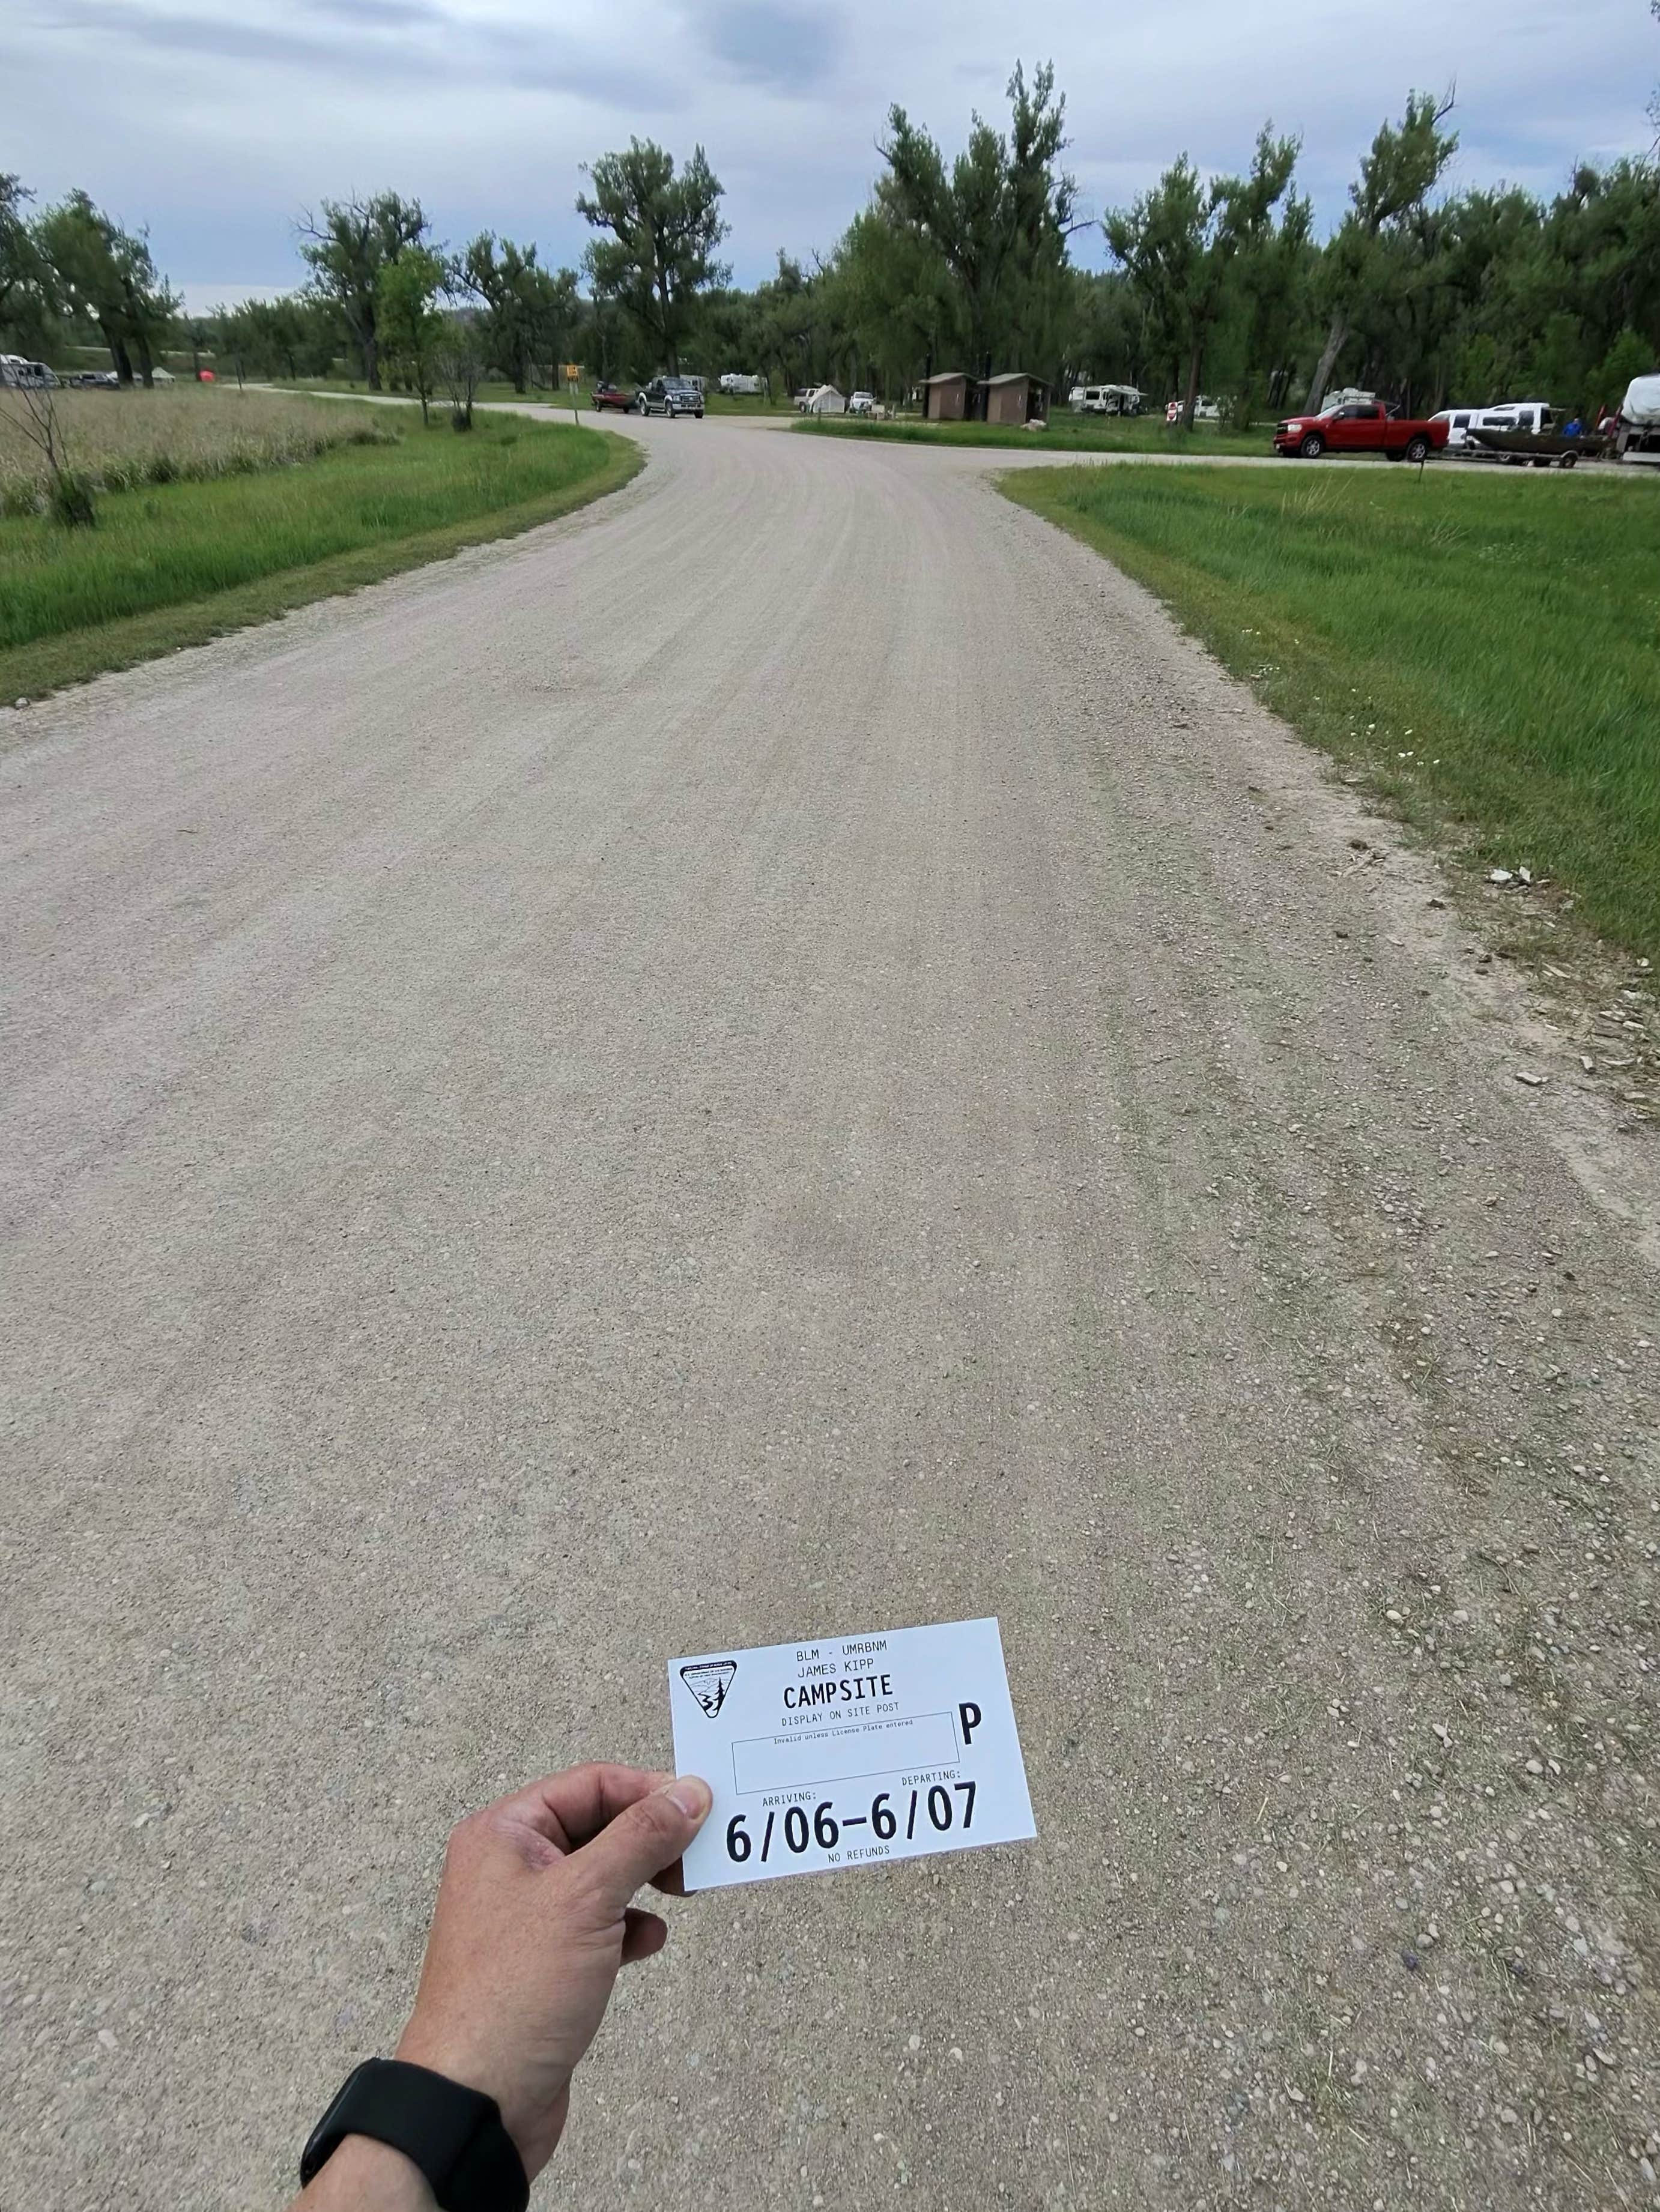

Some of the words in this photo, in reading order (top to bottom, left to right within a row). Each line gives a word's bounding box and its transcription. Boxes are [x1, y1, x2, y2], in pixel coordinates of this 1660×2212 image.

[796, 1649, 819, 1662] BLM
[842, 1640, 888, 1655] UMRBNM
[798, 1663, 837, 1678] JAMES
[844, 1658, 874, 1672] KIPP
[784, 1674, 893, 1709] CAMPSITE
[781, 1713, 823, 1726] DISPLAY
[829, 1710, 841, 1720] ON
[847, 1706, 870, 1717] SITE
[877, 1702, 899, 1713] POST
[959, 1702, 982, 1745] P
[774, 1734, 802, 1744] Invalid
[805, 1732, 829, 1740] unless
[832, 1728, 859, 1736] License
[886, 1720, 913, 1728] entered
[901, 1770, 961, 1786] DEPARTING:
[762, 1791, 817, 1807] ARRIVING:
[727, 1781, 977, 1863] 6/06-6/07
[828, 1852, 841, 1863] NO
[847, 1845, 890, 1861] REFUNDS
